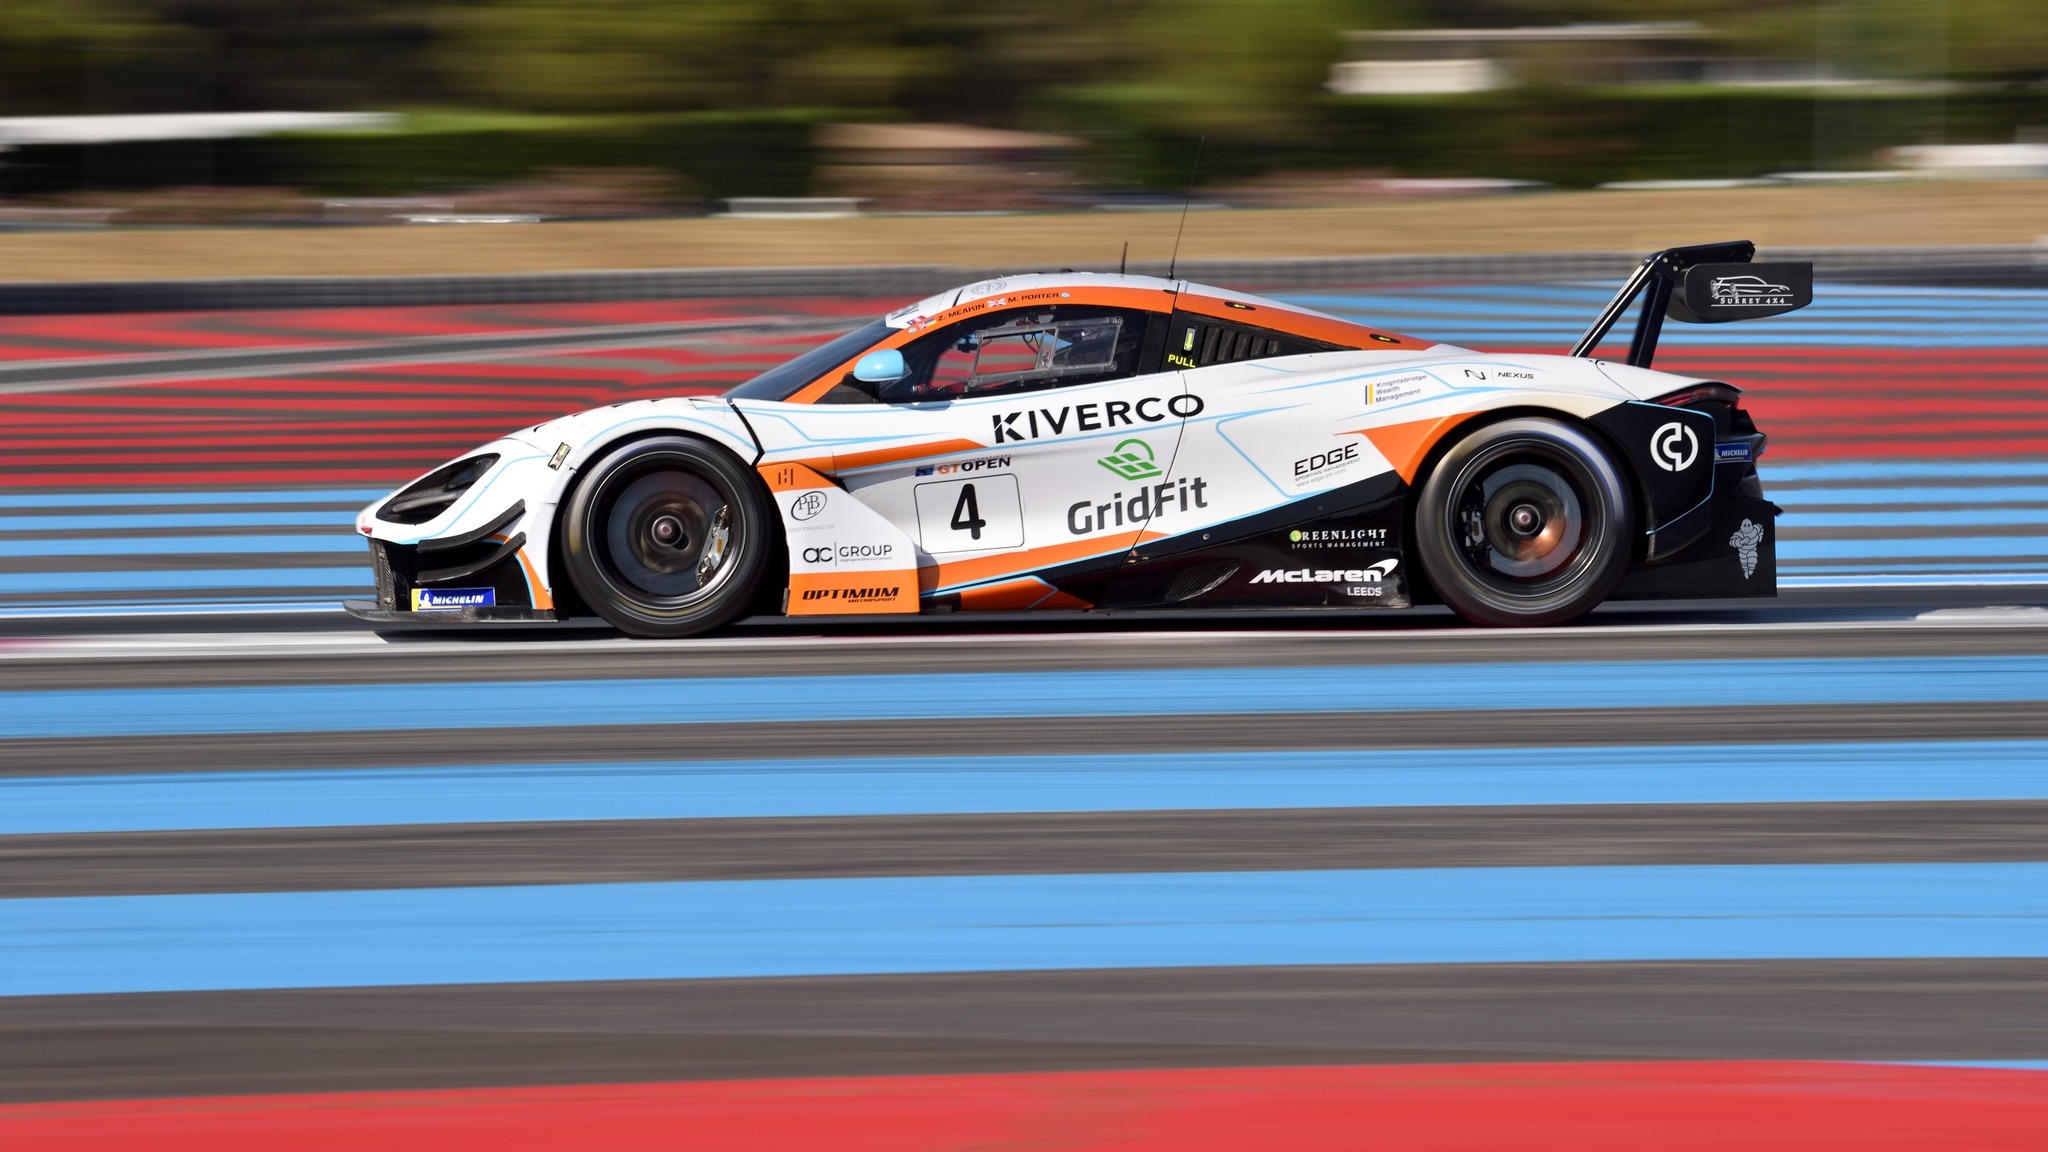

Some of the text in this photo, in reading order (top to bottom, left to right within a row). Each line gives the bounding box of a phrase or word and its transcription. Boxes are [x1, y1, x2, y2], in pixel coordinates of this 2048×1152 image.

[1021, 292, 1059, 301] PORTER
[948, 303, 985, 318] MEAKIN
[1168, 353, 1196, 368] PULL
[1376, 374, 1427, 388] Knightsbridge
[1497, 371, 1534, 379] NEXUS
[1375, 388, 1421, 403] Management
[1376, 385, 1400, 395] Wealth
[992, 393, 1204, 444] KIVERCO
[1295, 442, 1358, 476] EDGE
[1721, 449, 1748, 457] MICHELIN
[950, 483, 986, 540] 4
[1067, 476, 1208, 535] GridFit
[839, 545, 893, 557] GROUP
[1327, 540, 1386, 549] MANAGEMENT
[1249, 569, 1382, 583] McLaren
[802, 587, 899, 600] OPTIMUM
[1347, 586, 1382, 596] LEEDS
[432, 595, 484, 605] MICHELIN
